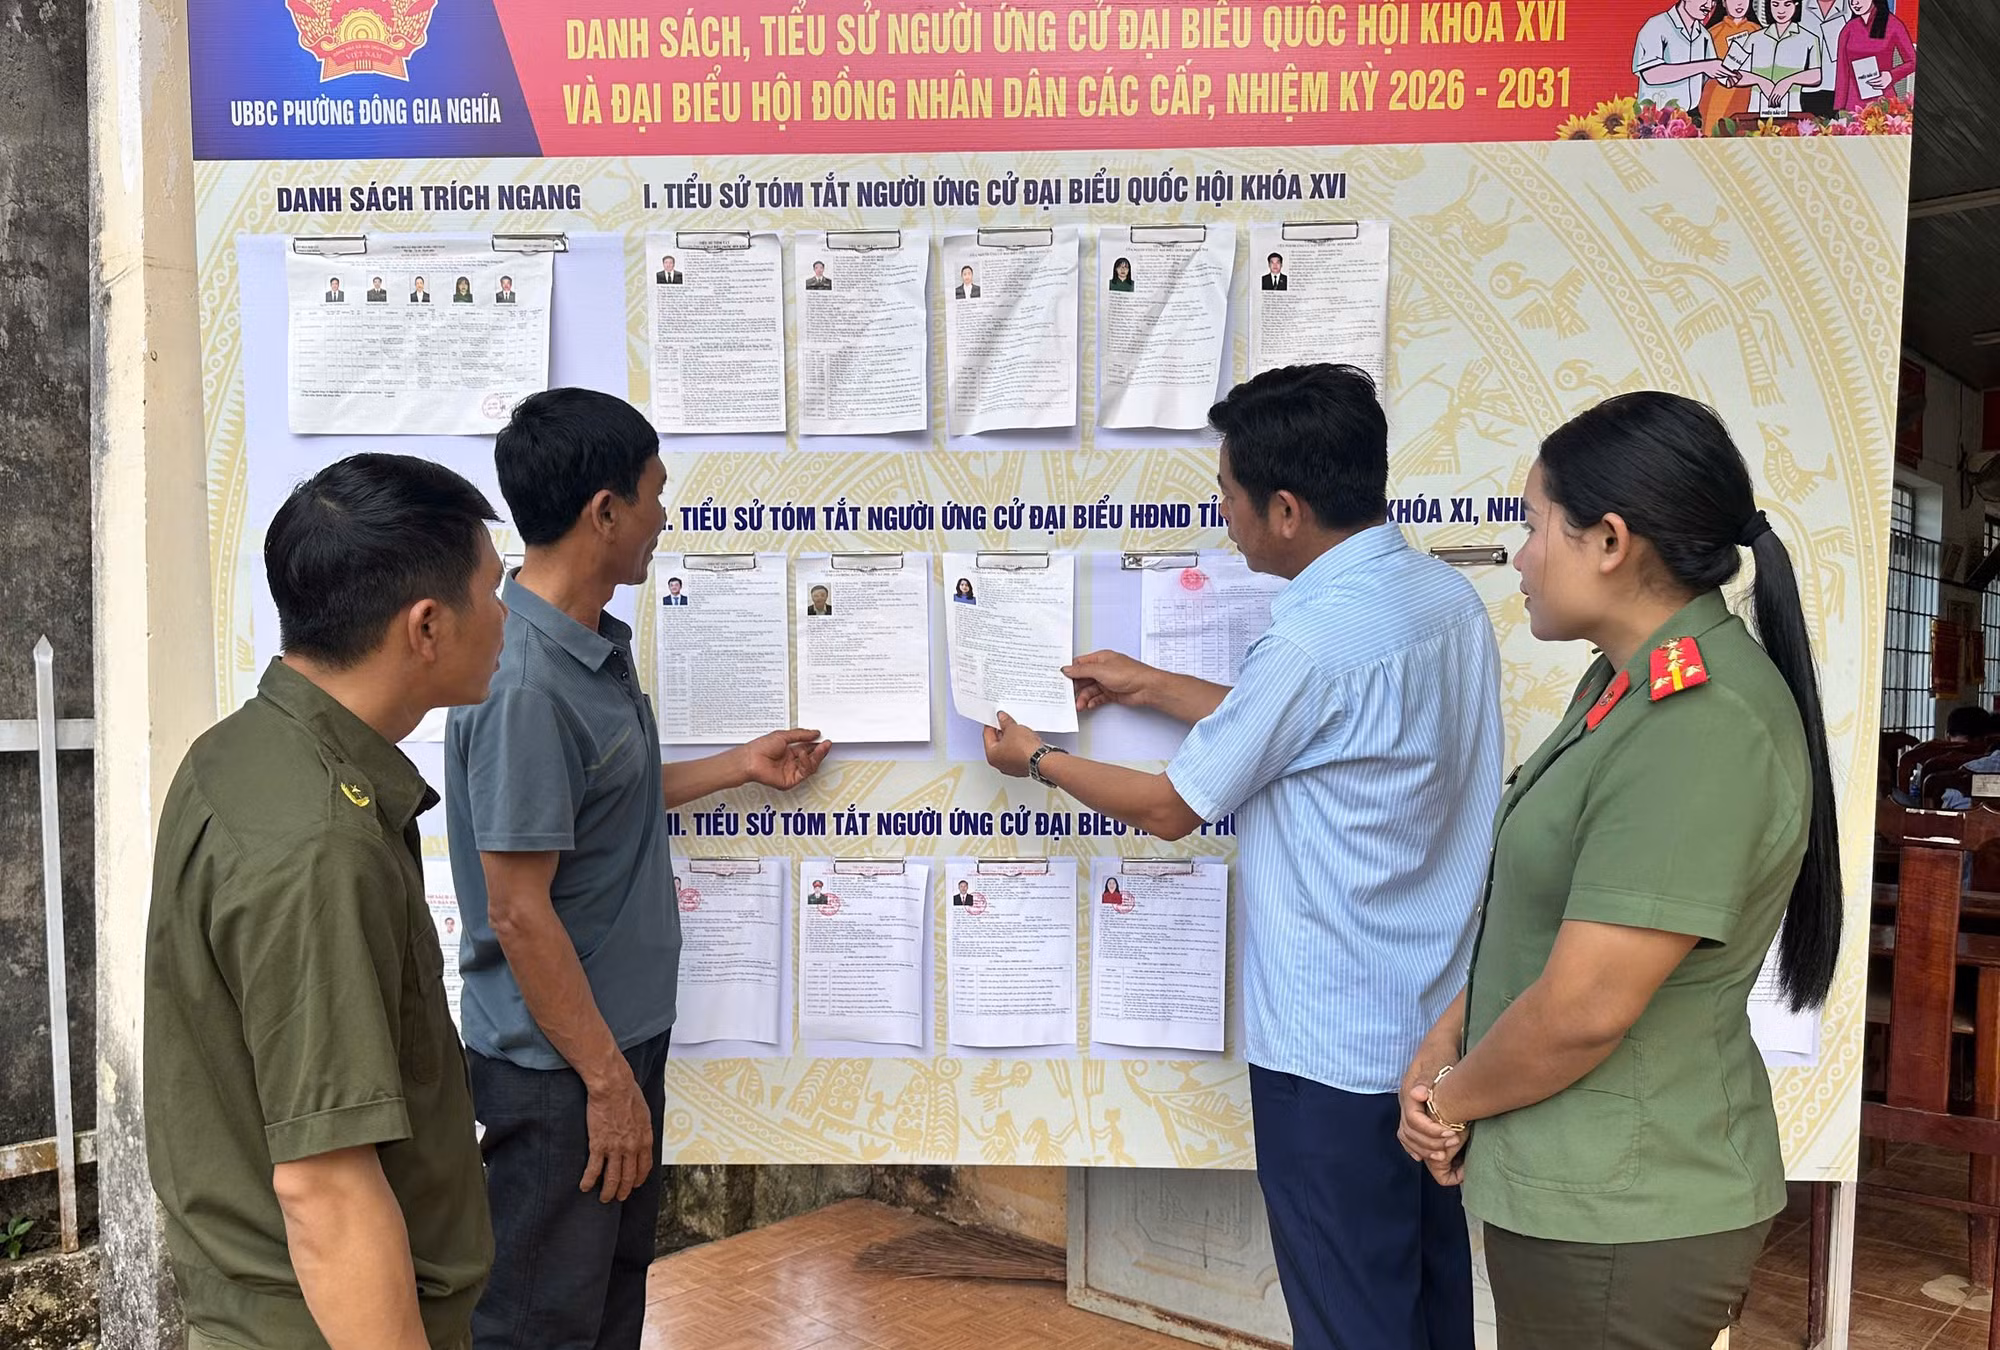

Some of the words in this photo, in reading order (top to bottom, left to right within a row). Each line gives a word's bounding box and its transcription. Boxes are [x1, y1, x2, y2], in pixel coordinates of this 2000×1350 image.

[566, 18, 649, 60] DANH
[659, 7, 750, 62] SÁCH,
[760, 0, 826, 56] TIỂU
[836, 0, 880, 55] SỬ
[888, 1, 982, 54] NGƯỜI
[993, 2, 1057, 53] ỨNG
[1118, 9, 1170, 59] ĐẠI
[1515, 0, 1566, 42] XVI
[230, 99, 278, 126] UBBC
[283, 93, 354, 126] PHƯỜNG
[359, 93, 406, 125] ĐÔNG
[412, 98, 442, 124] GIA
[448, 93, 502, 123] NGHĨA
[562, 75, 602, 124] VÀ
[611, 82, 662, 133] ĐẠI
[672, 64, 741, 123] BIỂU
[752, 72, 801, 131] HỘI
[812, 65, 896, 121] ĐỒNG
[907, 69, 992, 120] NHÂN
[1003, 68, 1067, 118] DÂN
[1078, 66, 1139, 117] CÁC
[1150, 59, 1215, 120] CẤP,
[1226, 62, 1329, 123] NHIỆM
[1339, 61, 1379, 112] KỲ
[1388, 68, 1465, 111] 2026
[1475, 87, 1487, 96] -
[1497, 66, 1570, 109] 2031
[277, 186, 342, 213] DANH
[350, 181, 413, 212] SÁCH
[420, 180, 491, 212] TRÍCH
[498, 184, 582, 211] NGANG
[643, 184, 658, 209] I.
[664, 172, 712, 209] TIỂU
[719, 174, 751, 209] SỬ
[756, 177, 803, 208] TÓM
[810, 172, 850, 208] TẮT
[857, 174, 926, 207] NGƯỜI
[933, 175, 980, 207] ỨNG
[986, 171, 1019, 206] CỬ
[1023, 178, 1062, 210] ĐẠI
[1069, 167, 1120, 204] BIỂU
[1127, 168, 1188, 206] QUỐC
[1196, 170, 1234, 207] HỘI
[1241, 168, 1303, 201] KHÓA
[1309, 173, 1347, 199] XVI
[680, 497, 727, 531] TIỂU
[734, 498, 765, 531] SỬ
[769, 502, 816, 531] TÓM
[823, 498, 861, 531] TẮT
[868, 500, 934, 530] NGƯỜI
[942, 501, 987, 530] ỨNG
[993, 497, 1025, 530] CỬ
[1029, 504, 1066, 535] ĐẠI
[1073, 494, 1123, 529] BIỂU
[1130, 503, 1191, 528] HĐND
[1449, 498, 1479, 526] XI,
[693, 803, 739, 836] TIỂU
[746, 805, 777, 836] SỬ
[781, 808, 827, 836] TÓM
[833, 804, 870, 836] TẮT
[877, 806, 942, 836] NGƯỜI
[949, 807, 993, 836] ỨNG
[1000, 804, 1031, 836] CỬ
[1035, 812, 1071, 841] ĐẠI
